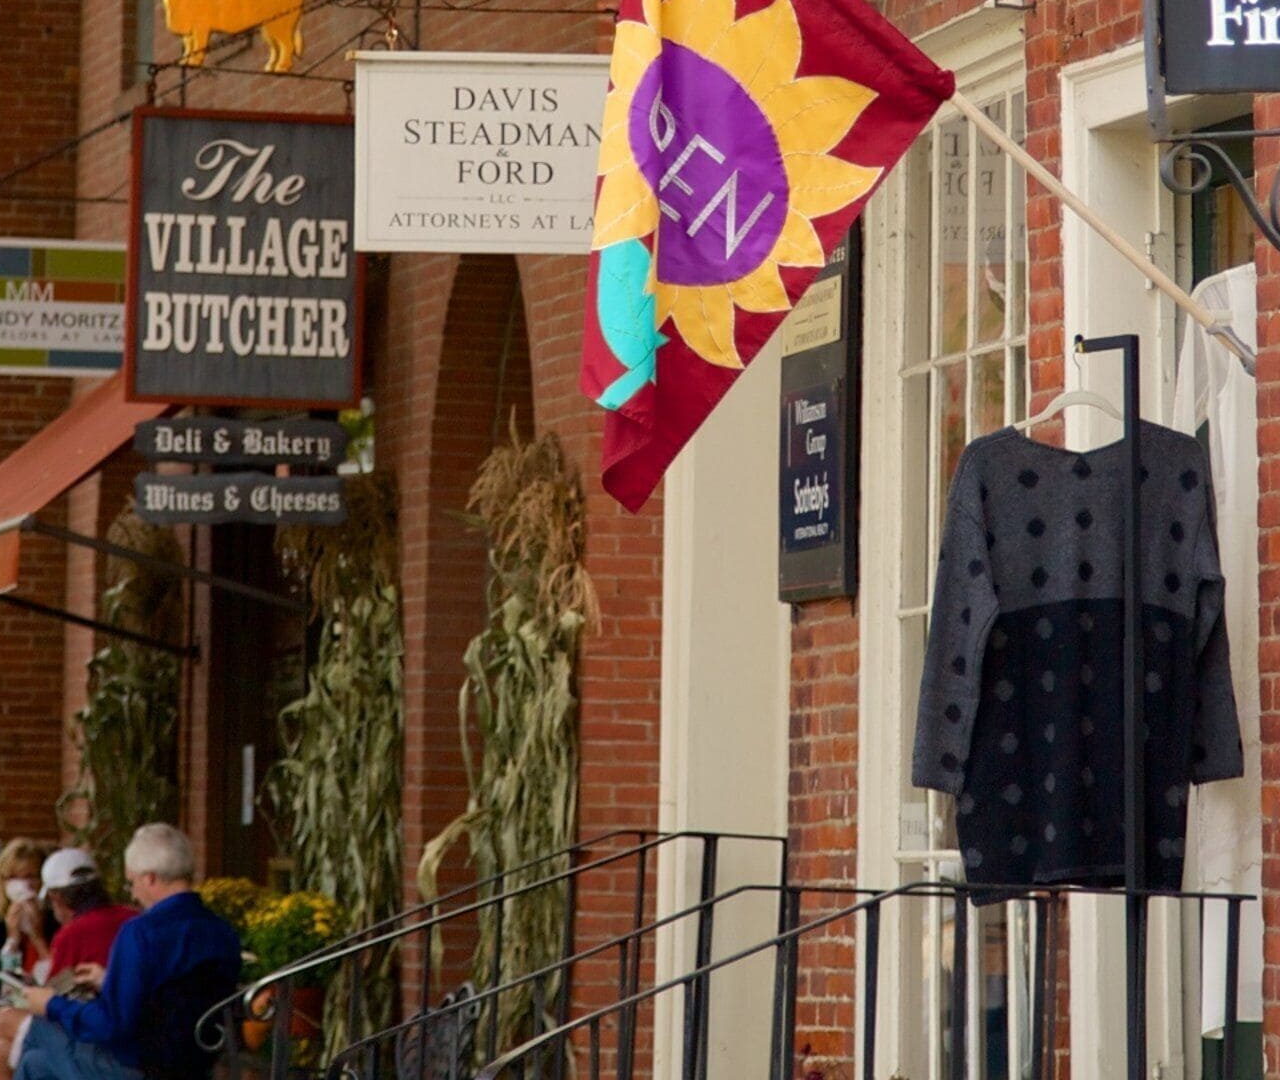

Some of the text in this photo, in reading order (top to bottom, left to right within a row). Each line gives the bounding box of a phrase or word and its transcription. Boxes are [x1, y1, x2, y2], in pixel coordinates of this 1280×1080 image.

[453, 86, 559, 113] DAVIS
[404, 119, 604, 147] STEADMAN
[496, 148, 510, 159] &
[181, 139, 306, 206] The
[457, 160, 554, 185] FORD
[490, 194, 517, 205] LLC
[389, 213, 595, 231] ATTORNEYS AT LA
[144, 212, 348, 279] VILLAGE
[6, 280, 55, 303] MM
[40, 311, 120, 330] MORITZ
[142, 291, 350, 359] BUTCHER
[60, 331, 81, 343] AT
[155, 425, 331, 461] Deli & Bakery
[144, 484, 340, 518] Wines & Cheeses
